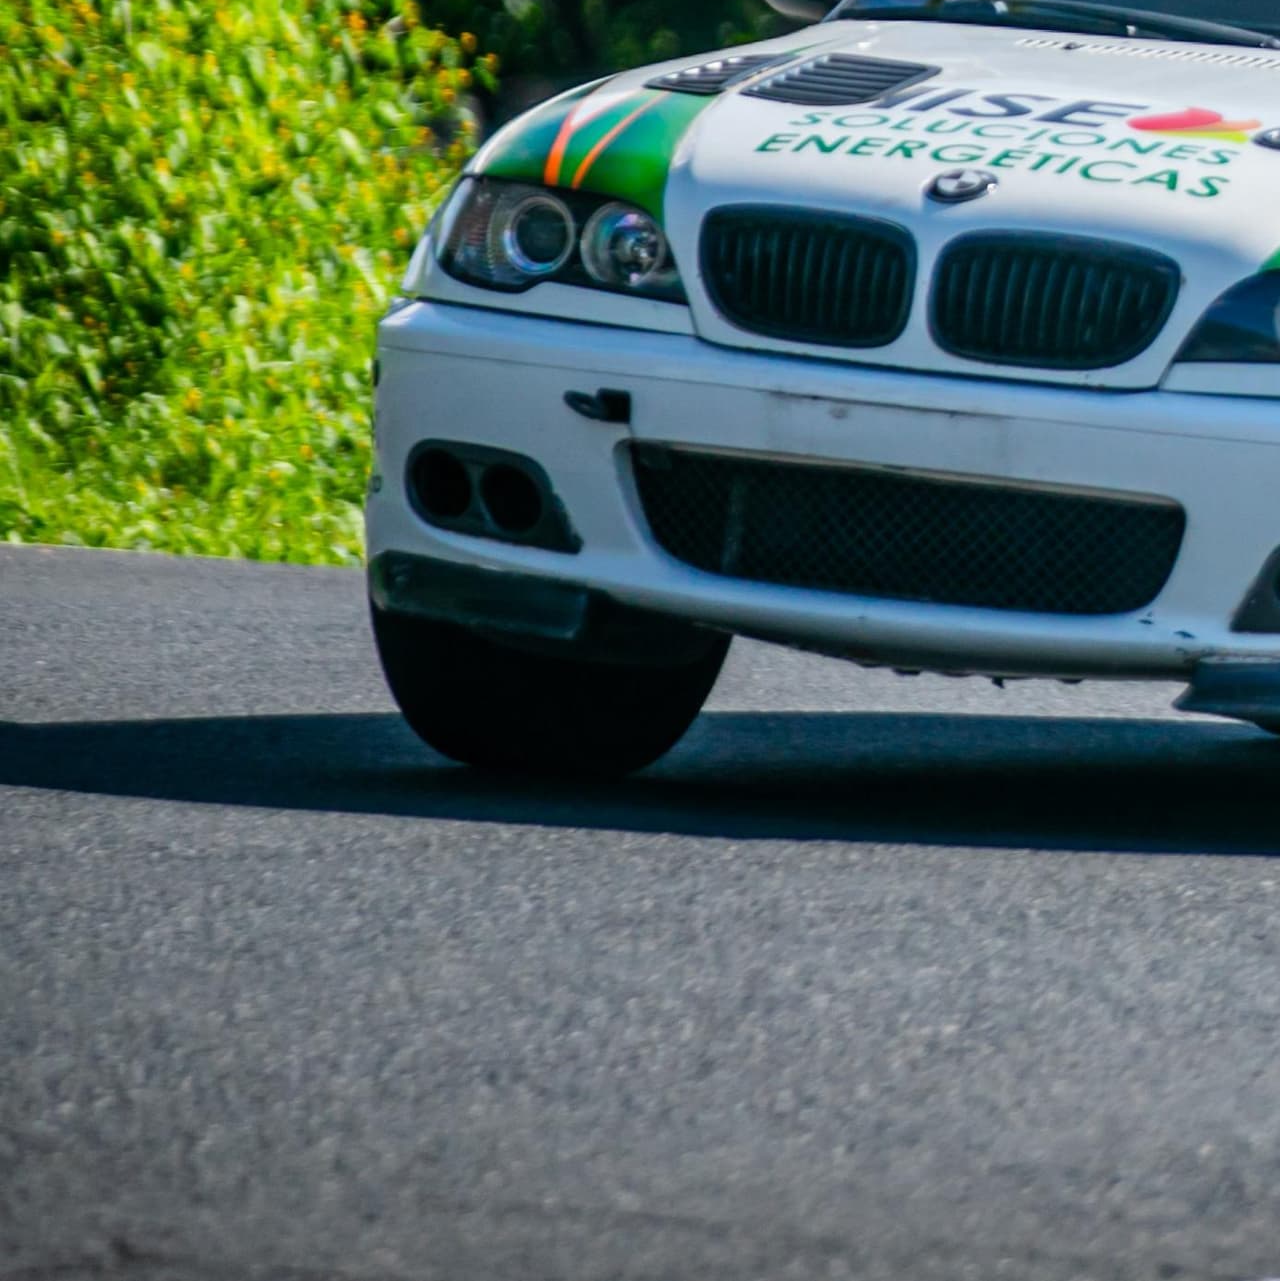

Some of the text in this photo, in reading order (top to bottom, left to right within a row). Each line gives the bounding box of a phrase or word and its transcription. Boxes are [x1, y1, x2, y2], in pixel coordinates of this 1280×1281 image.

[873, 86, 1148, 127] IISE
[755, 132, 1229, 198] ENERGÉTICAS
[789, 112, 1238, 166] SOLUCIONES
